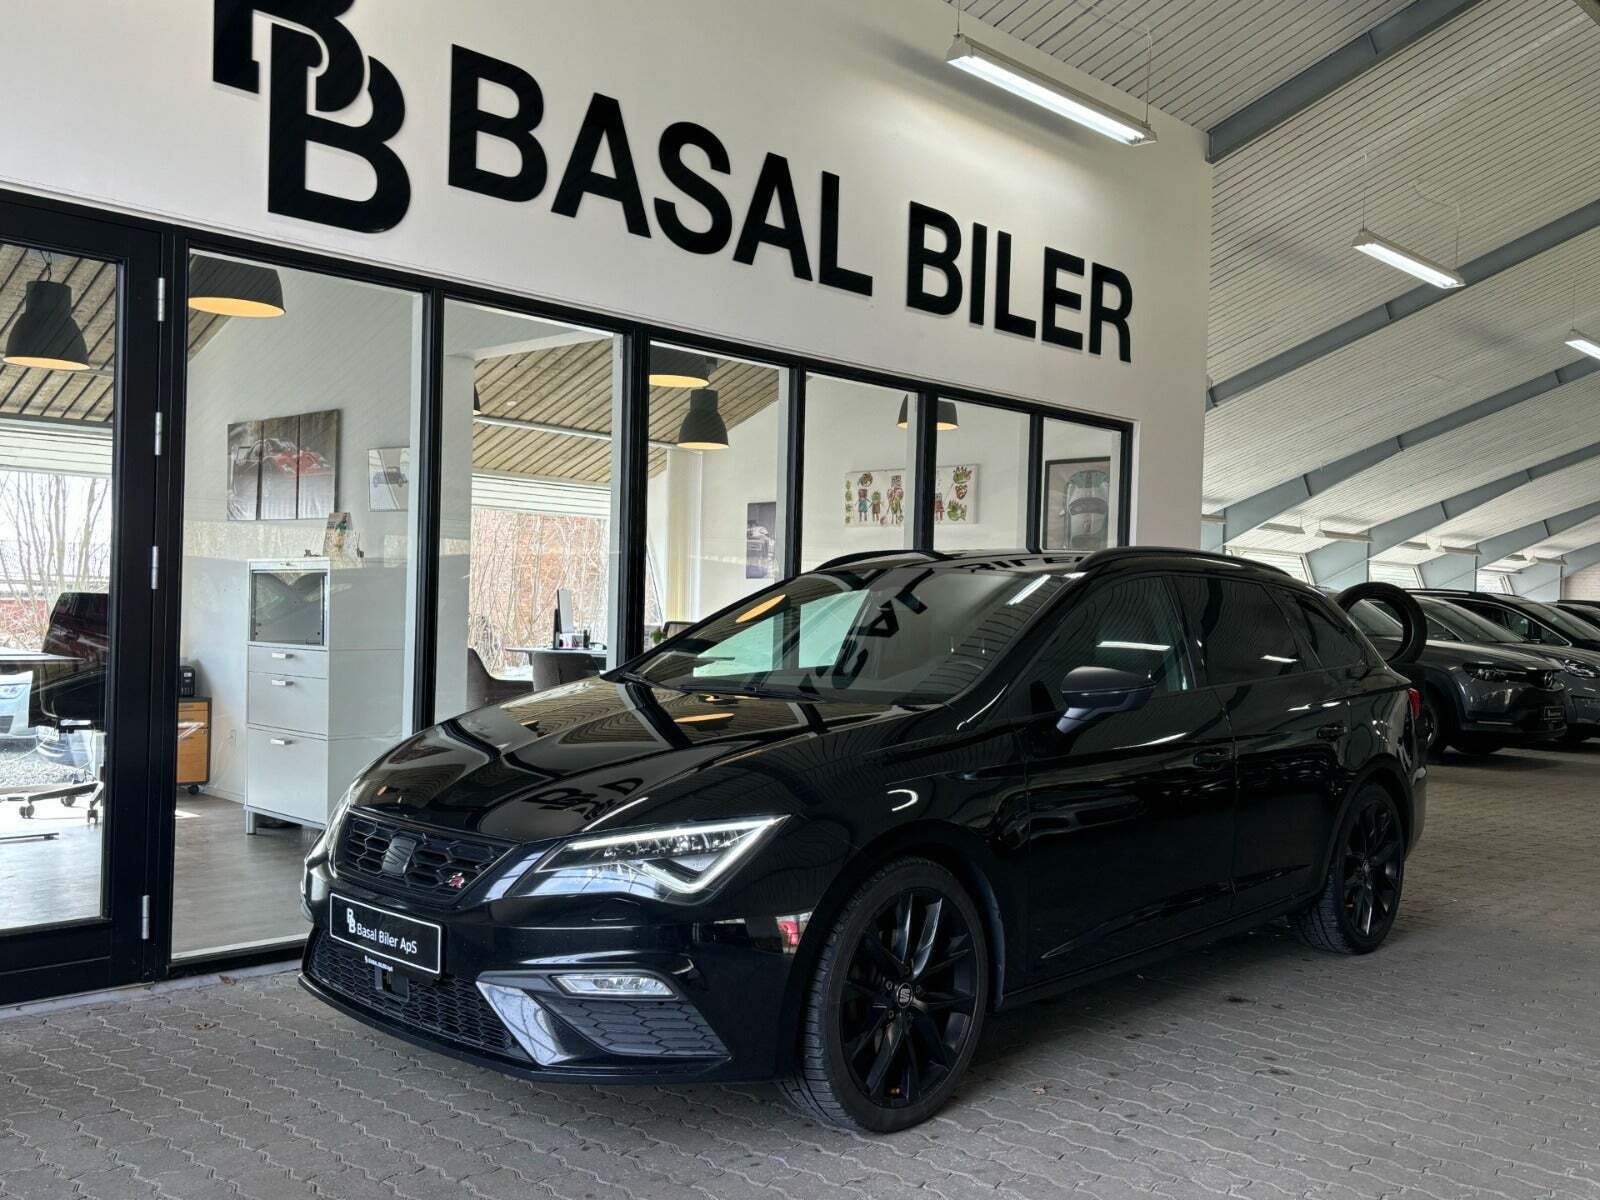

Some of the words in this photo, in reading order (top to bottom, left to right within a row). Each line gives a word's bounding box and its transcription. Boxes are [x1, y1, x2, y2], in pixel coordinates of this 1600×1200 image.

[447, 43, 874, 298] BASAL
[906, 200, 1134, 364] BILER
[357, 923, 377, 941] Basal
[378, 931, 398, 947] Biler
[400, 938, 418, 954] ApS
